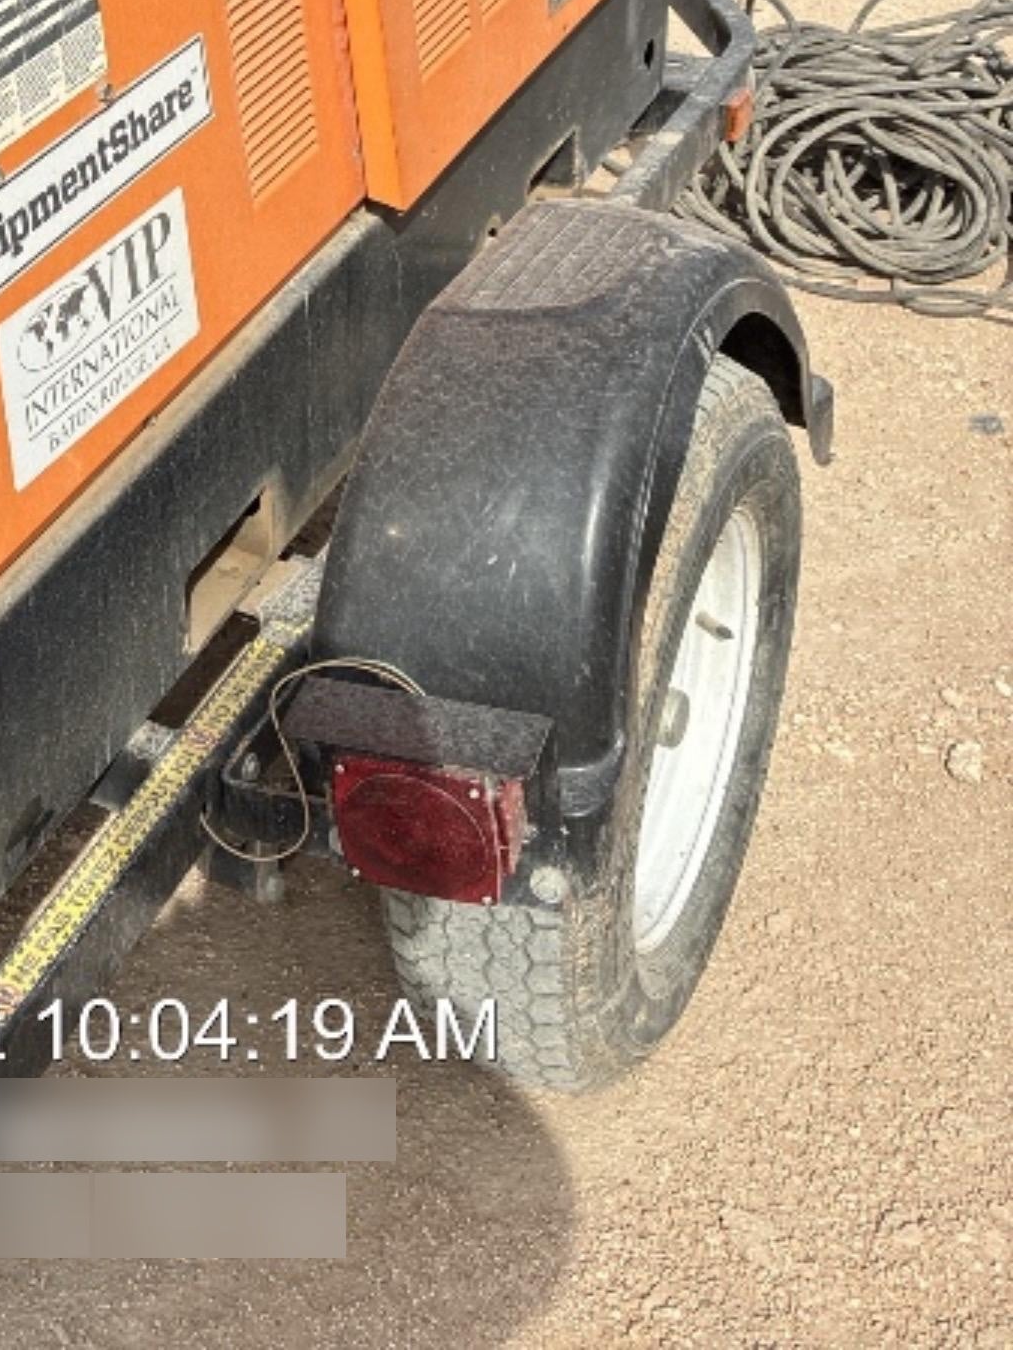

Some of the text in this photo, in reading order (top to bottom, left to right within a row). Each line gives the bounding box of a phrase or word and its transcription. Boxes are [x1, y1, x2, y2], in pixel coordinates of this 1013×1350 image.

[85, 212, 172, 323] VIP
[25, 284, 180, 432] INTERNATIONAL
[49, 400, 96, 453] BATON
